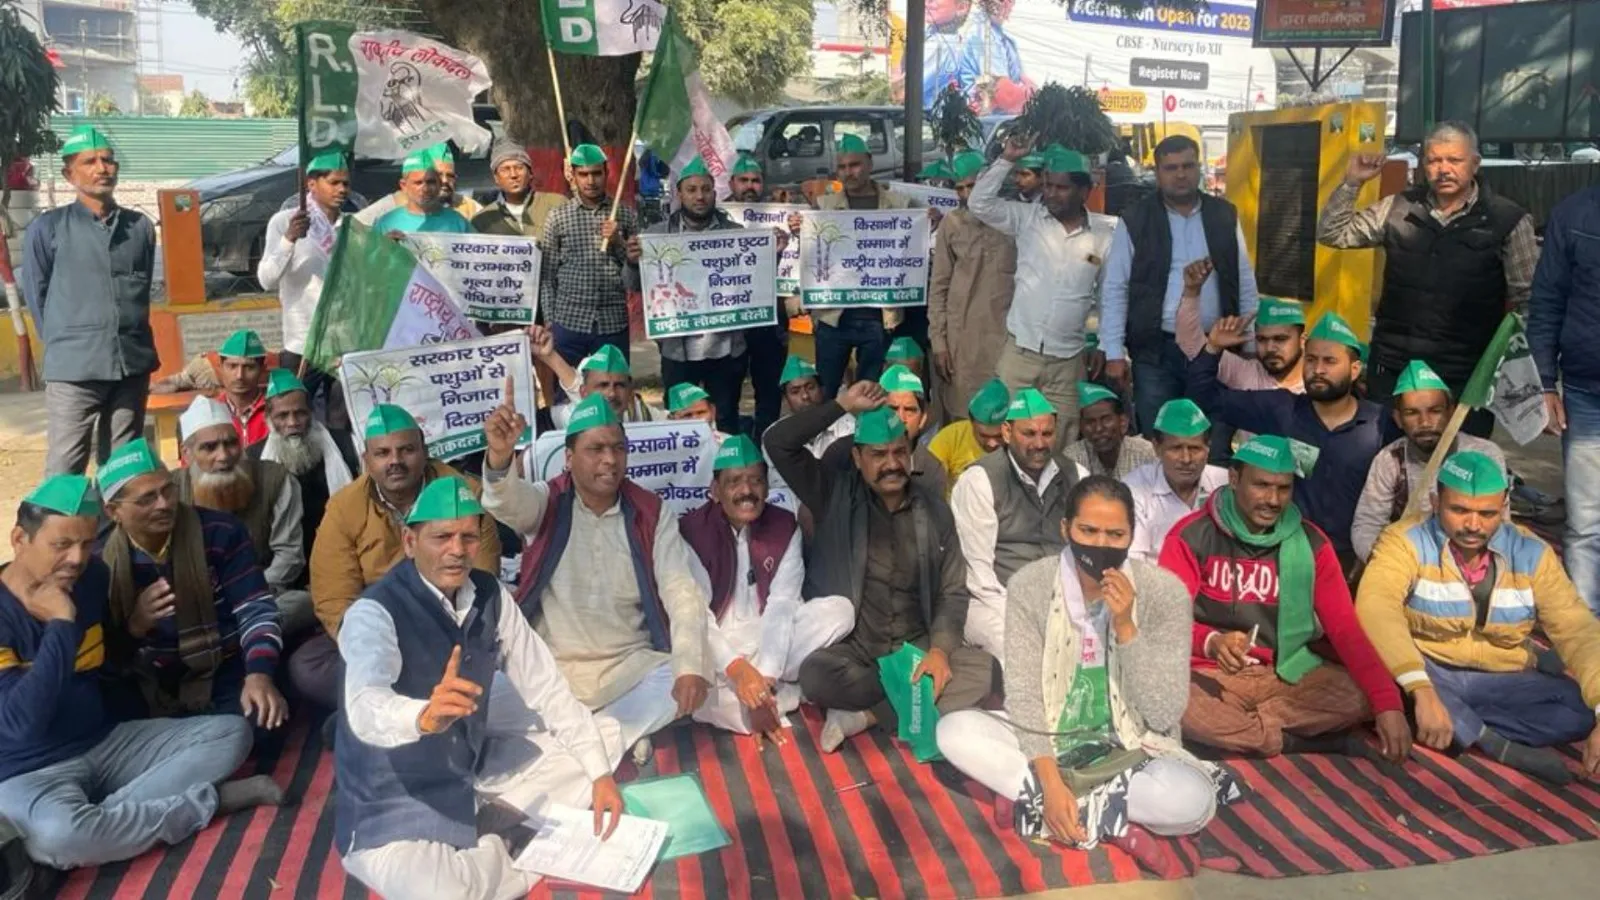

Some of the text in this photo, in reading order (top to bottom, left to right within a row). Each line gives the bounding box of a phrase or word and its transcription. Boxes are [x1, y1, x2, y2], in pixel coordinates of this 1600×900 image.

[1220, 13, 1251, 31] 2023
[1116, 35, 1142, 49] CBSE
[1153, 38, 1193, 56] Nursery
[411, 47, 479, 80] लोकदल
[1139, 66, 1202, 82] Register Now
[1180, 98, 1204, 110] Green
[854, 216, 912, 231] किसानों के
[451, 243, 499, 255] सरकार
[688, 238, 735, 252] सरकार
[856, 235, 911, 250] सम्मान में
[451, 260, 532, 273] का लाभकारी
[702, 252, 757, 273] पशुओं से
[841, 253, 923, 272] राष्ट्रीय लोकदल
[462, 278, 493, 291] मूल्य
[708, 273, 752, 287] निजात
[860, 273, 906, 287] मैदान में
[500, 292, 525, 304] करें
[711, 290, 753, 307] दिलायें
[809, 288, 919, 303] राष्ट्रीय लोकदल बरेली
[655, 307, 770, 332] राष्ट्रीय लोकदल बरेली
[409, 348, 475, 367] सरकार
[430, 363, 506, 389] पशुओं से
[441, 388, 500, 407] निजात
[681, 430, 700, 449] के
[681, 455, 700, 474] में
